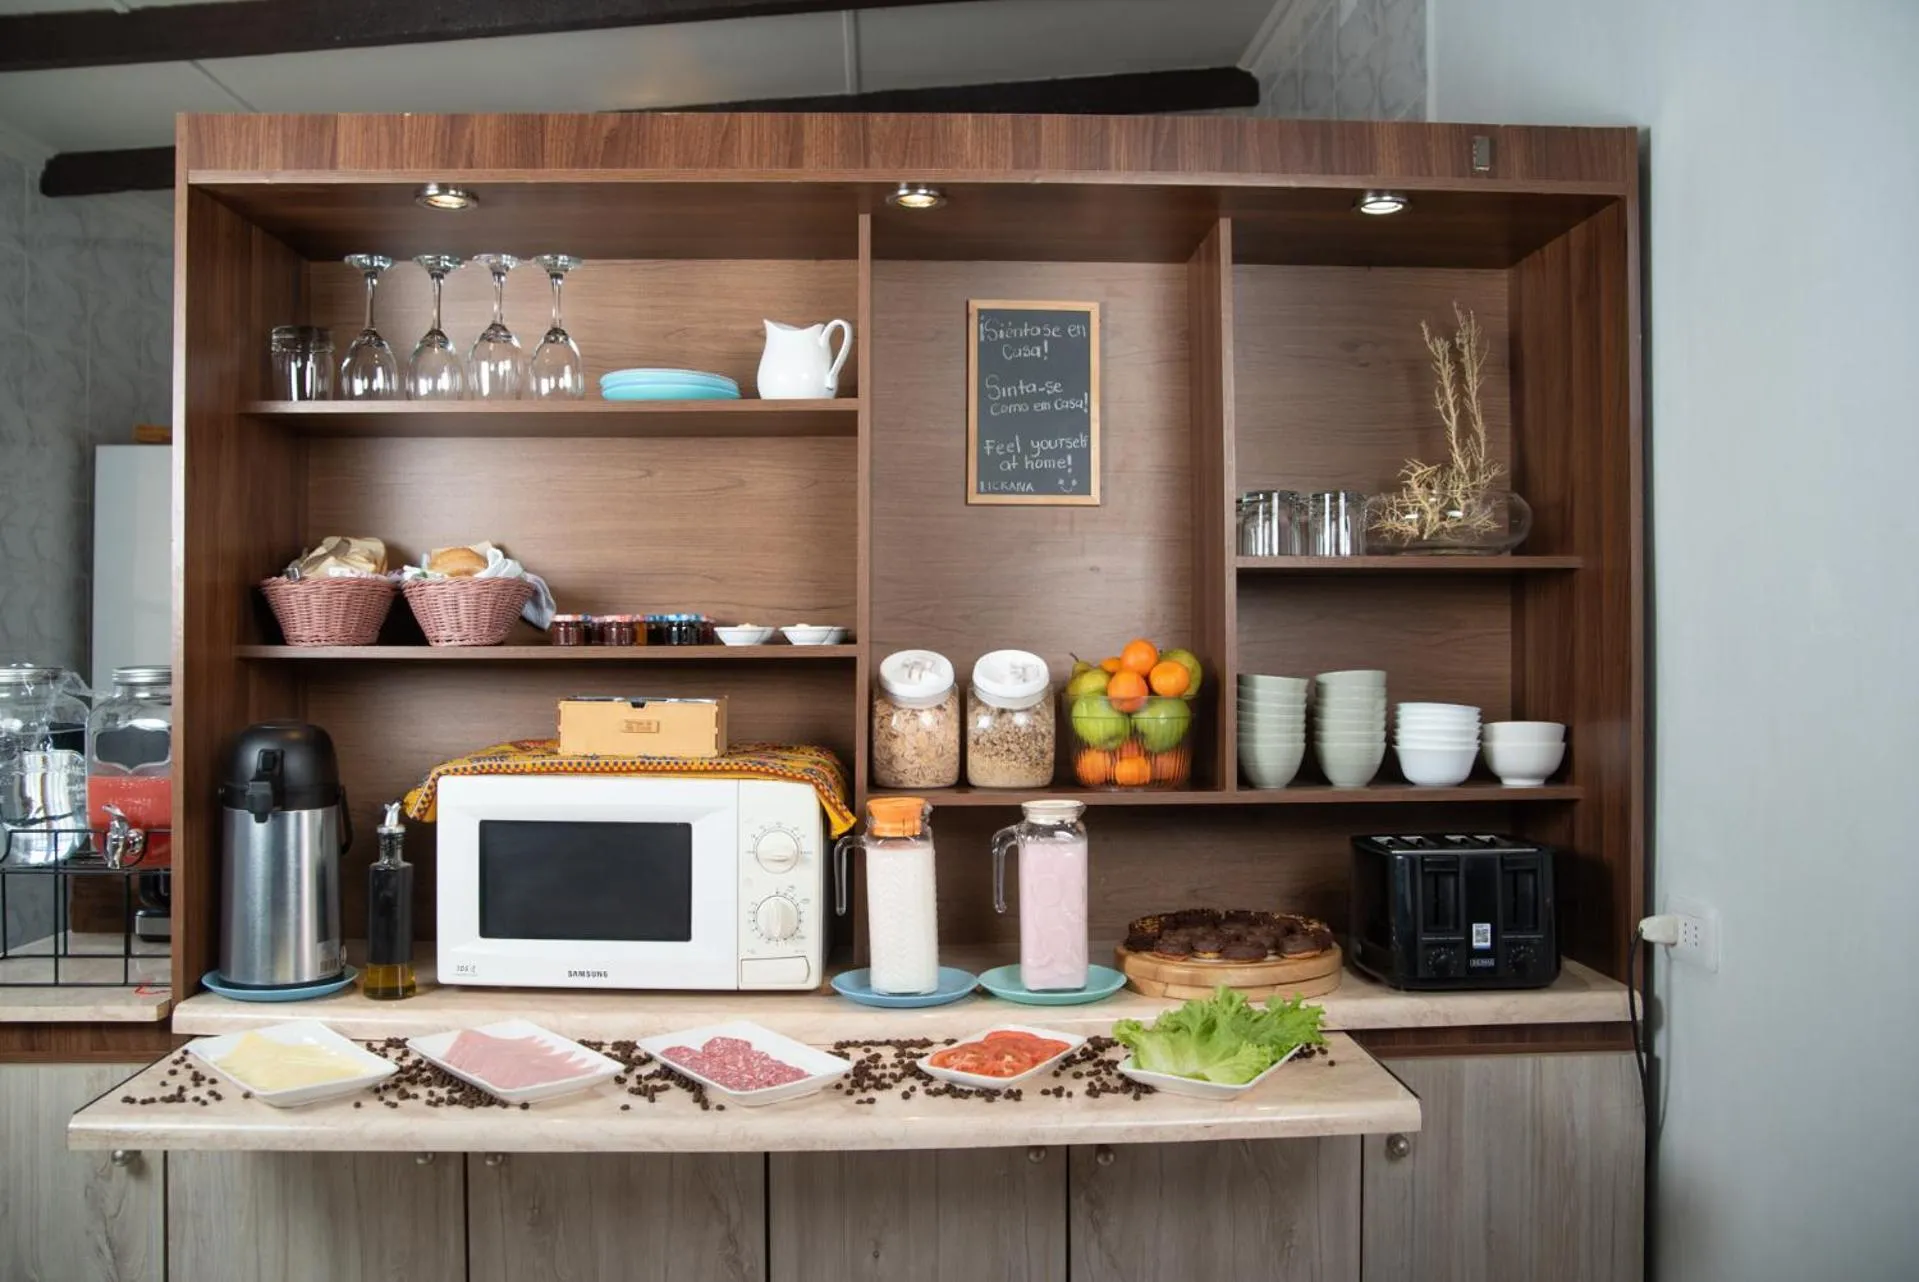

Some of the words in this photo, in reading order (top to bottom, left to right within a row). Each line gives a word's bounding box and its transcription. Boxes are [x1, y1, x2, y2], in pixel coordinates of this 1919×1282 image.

[1067, 323, 1086, 338] en
[985, 373, 1063, 400] Sinta-se
[984, 435, 1020, 456] Feel
[999, 455, 1019, 471] at
[1025, 454, 1072, 473] home!
[567, 970, 608, 978] SAMSUNG
